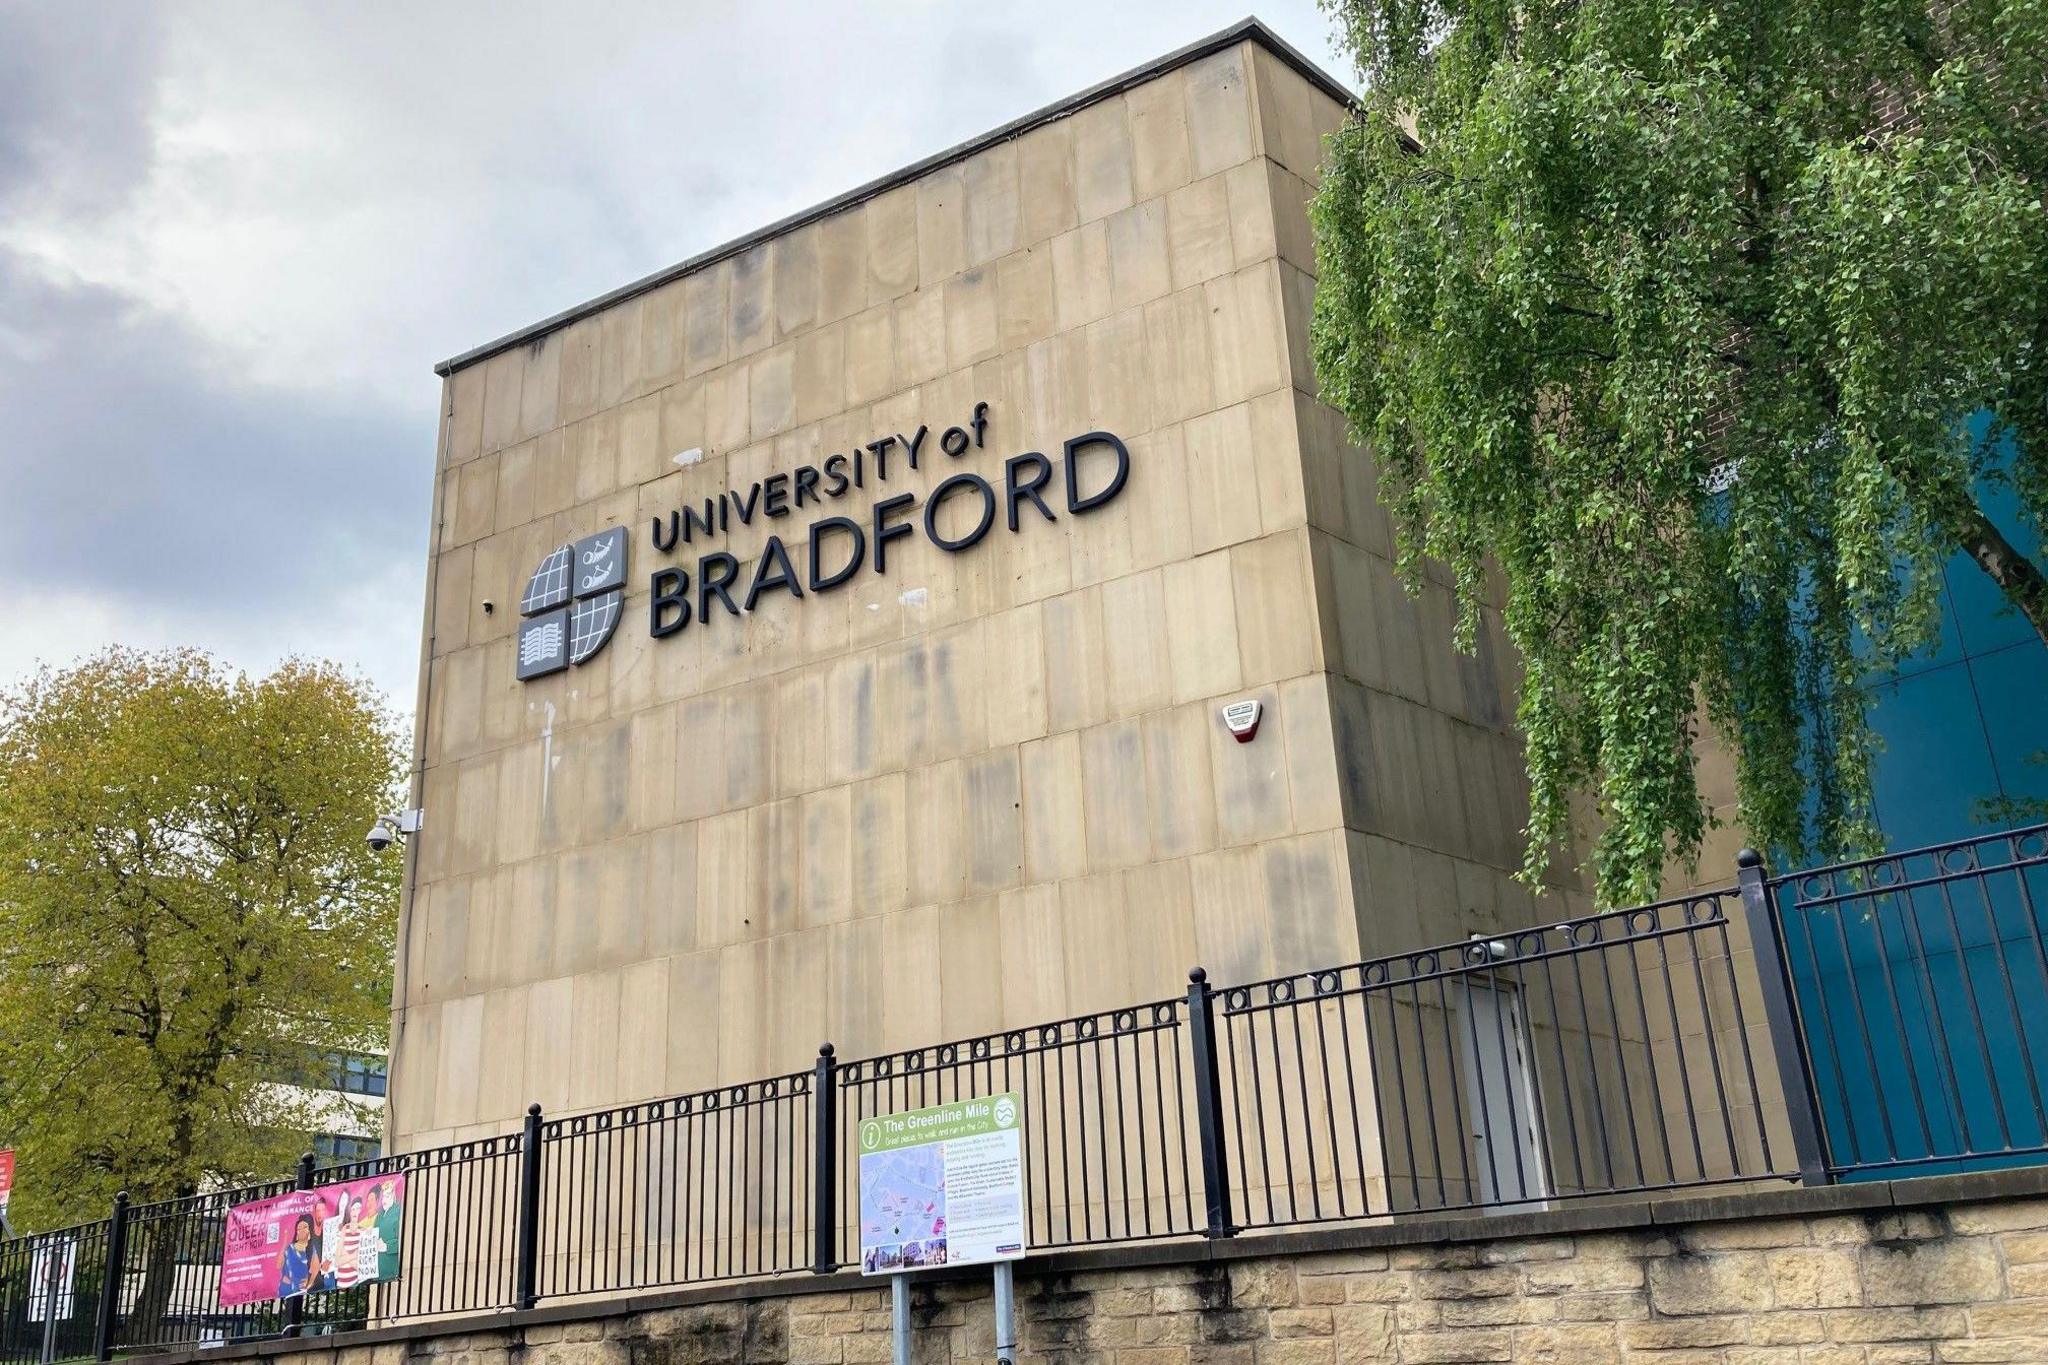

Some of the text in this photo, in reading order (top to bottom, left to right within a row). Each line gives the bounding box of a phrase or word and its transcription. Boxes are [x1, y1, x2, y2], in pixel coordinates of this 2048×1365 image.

[652, 401, 989, 553] UNIVERSITY of
[650, 430, 1131, 640] BRADFORD
[884, 1102, 990, 1133] The Greenline Mile
[229, 1223, 266, 1242] QUEER
[358, 1266, 377, 1276] NOW
